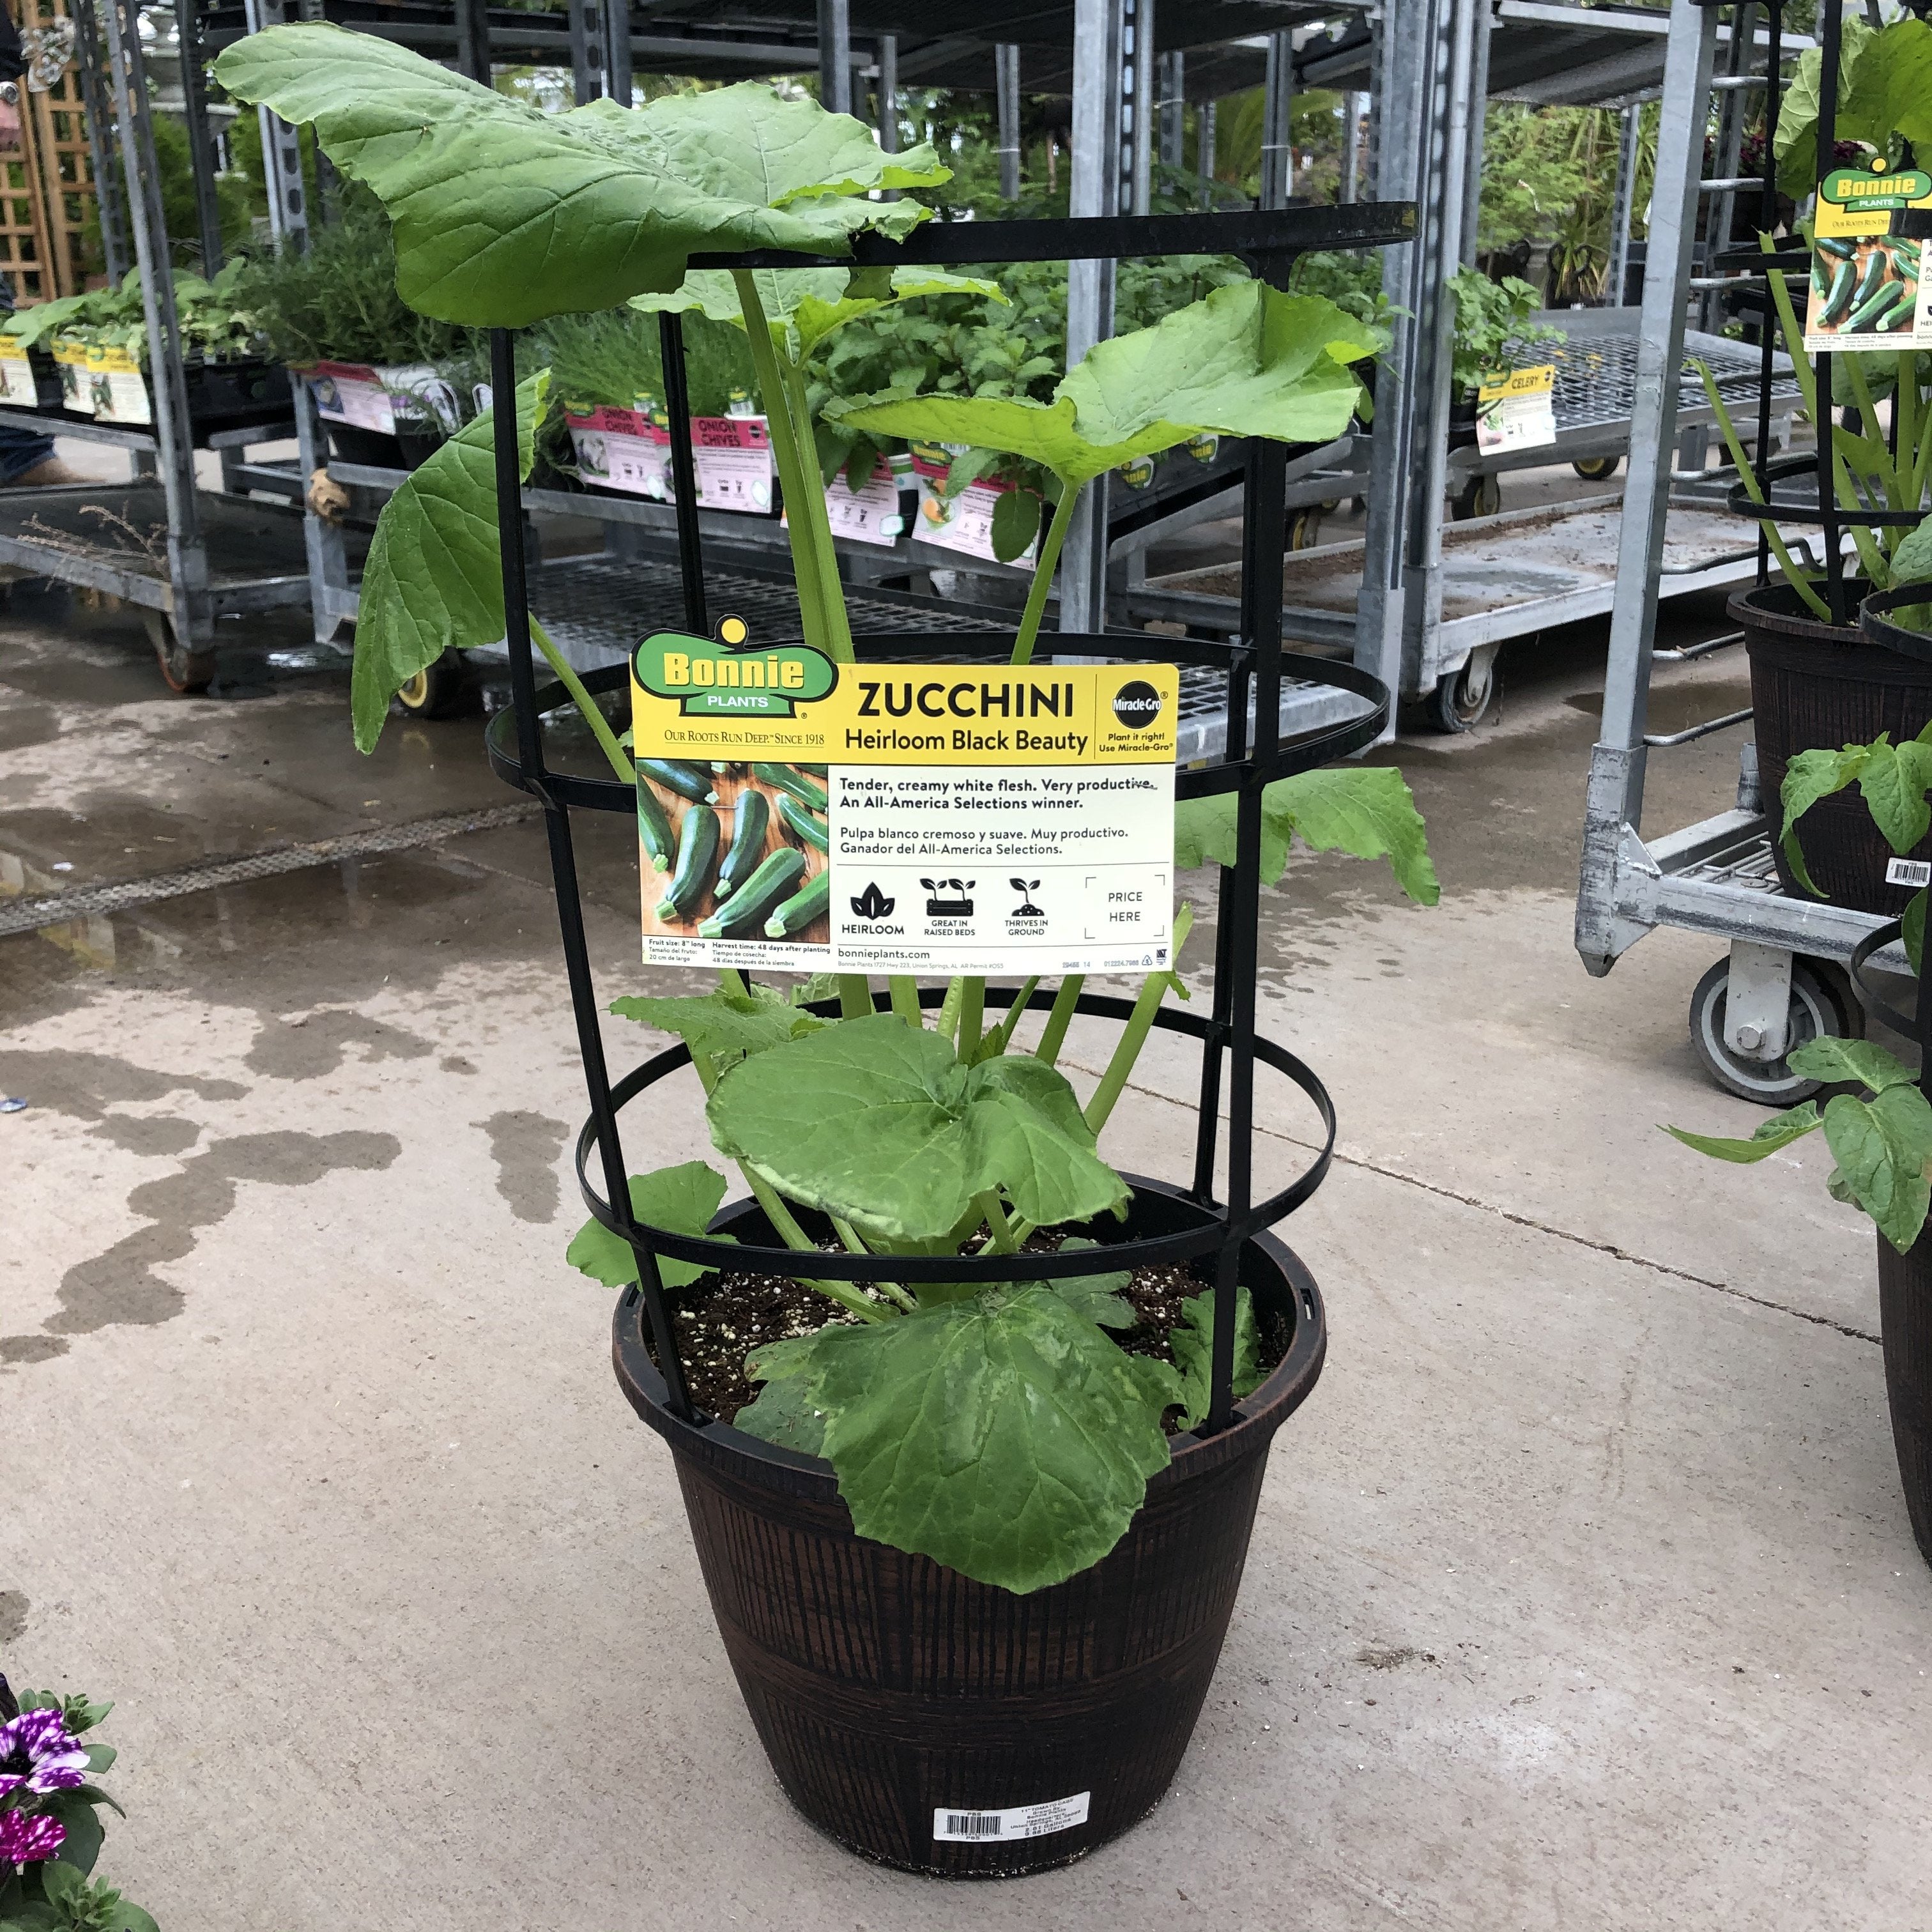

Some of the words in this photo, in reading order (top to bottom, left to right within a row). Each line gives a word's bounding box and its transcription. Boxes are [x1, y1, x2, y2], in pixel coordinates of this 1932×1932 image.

[1837, 176, 1915, 197] Bonnie
[1859, 199, 1894, 207] PLANTS
[1511, 375, 1539, 390] CELERY
[699, 420, 737, 433] ONION
[702, 434, 741, 447] CHIVES
[663, 652, 804, 689] Bonnie
[707, 695, 769, 709] PLANTS
[857, 683, 1073, 717] ZUCCHINI
[1112, 698, 1162, 712] Miracle-Gro
[804, 734, 824, 745] 1918
[845, 728, 945, 749] Heirloom
[953, 730, 1009, 750] Black
[1016, 730, 1088, 756] Beauty
[1108, 733, 1130, 741] Plant
[1141, 732, 1165, 742] right!
[1099, 744, 1116, 752] Use
[839, 778, 893, 793] Tender,
[898, 781, 949, 795] creamy
[953, 779, 993, 792] white
[998, 779, 1038, 792] flesh.
[1041, 779, 1073, 795] Very
[1077, 777, 1154, 795] productive.
[839, 795, 859, 808] An
[864, 795, 949, 809] All-America
[954, 797, 1027, 809] Selections
[1032, 797, 1083, 809] winner.
[840, 827, 874, 841] Pulpa
[878, 827, 919, 839] blanco
[923, 831, 975, 839] cremoso
[979, 831, 986, 843] y
[1031, 828, 1057, 842] Muy
[1061, 827, 1128, 842] productivo.
[840, 842, 893, 854] Ganador
[896, 843, 915, 854] del
[919, 844, 992, 854] All-America
[996, 844, 1062, 854] Selections.
[1108, 892, 1142, 902] PRICE
[1109, 912, 1141, 923] HERE
[842, 924, 905, 935] HEIRLOOM
[838, 948, 930, 960] bonnieplants.com
